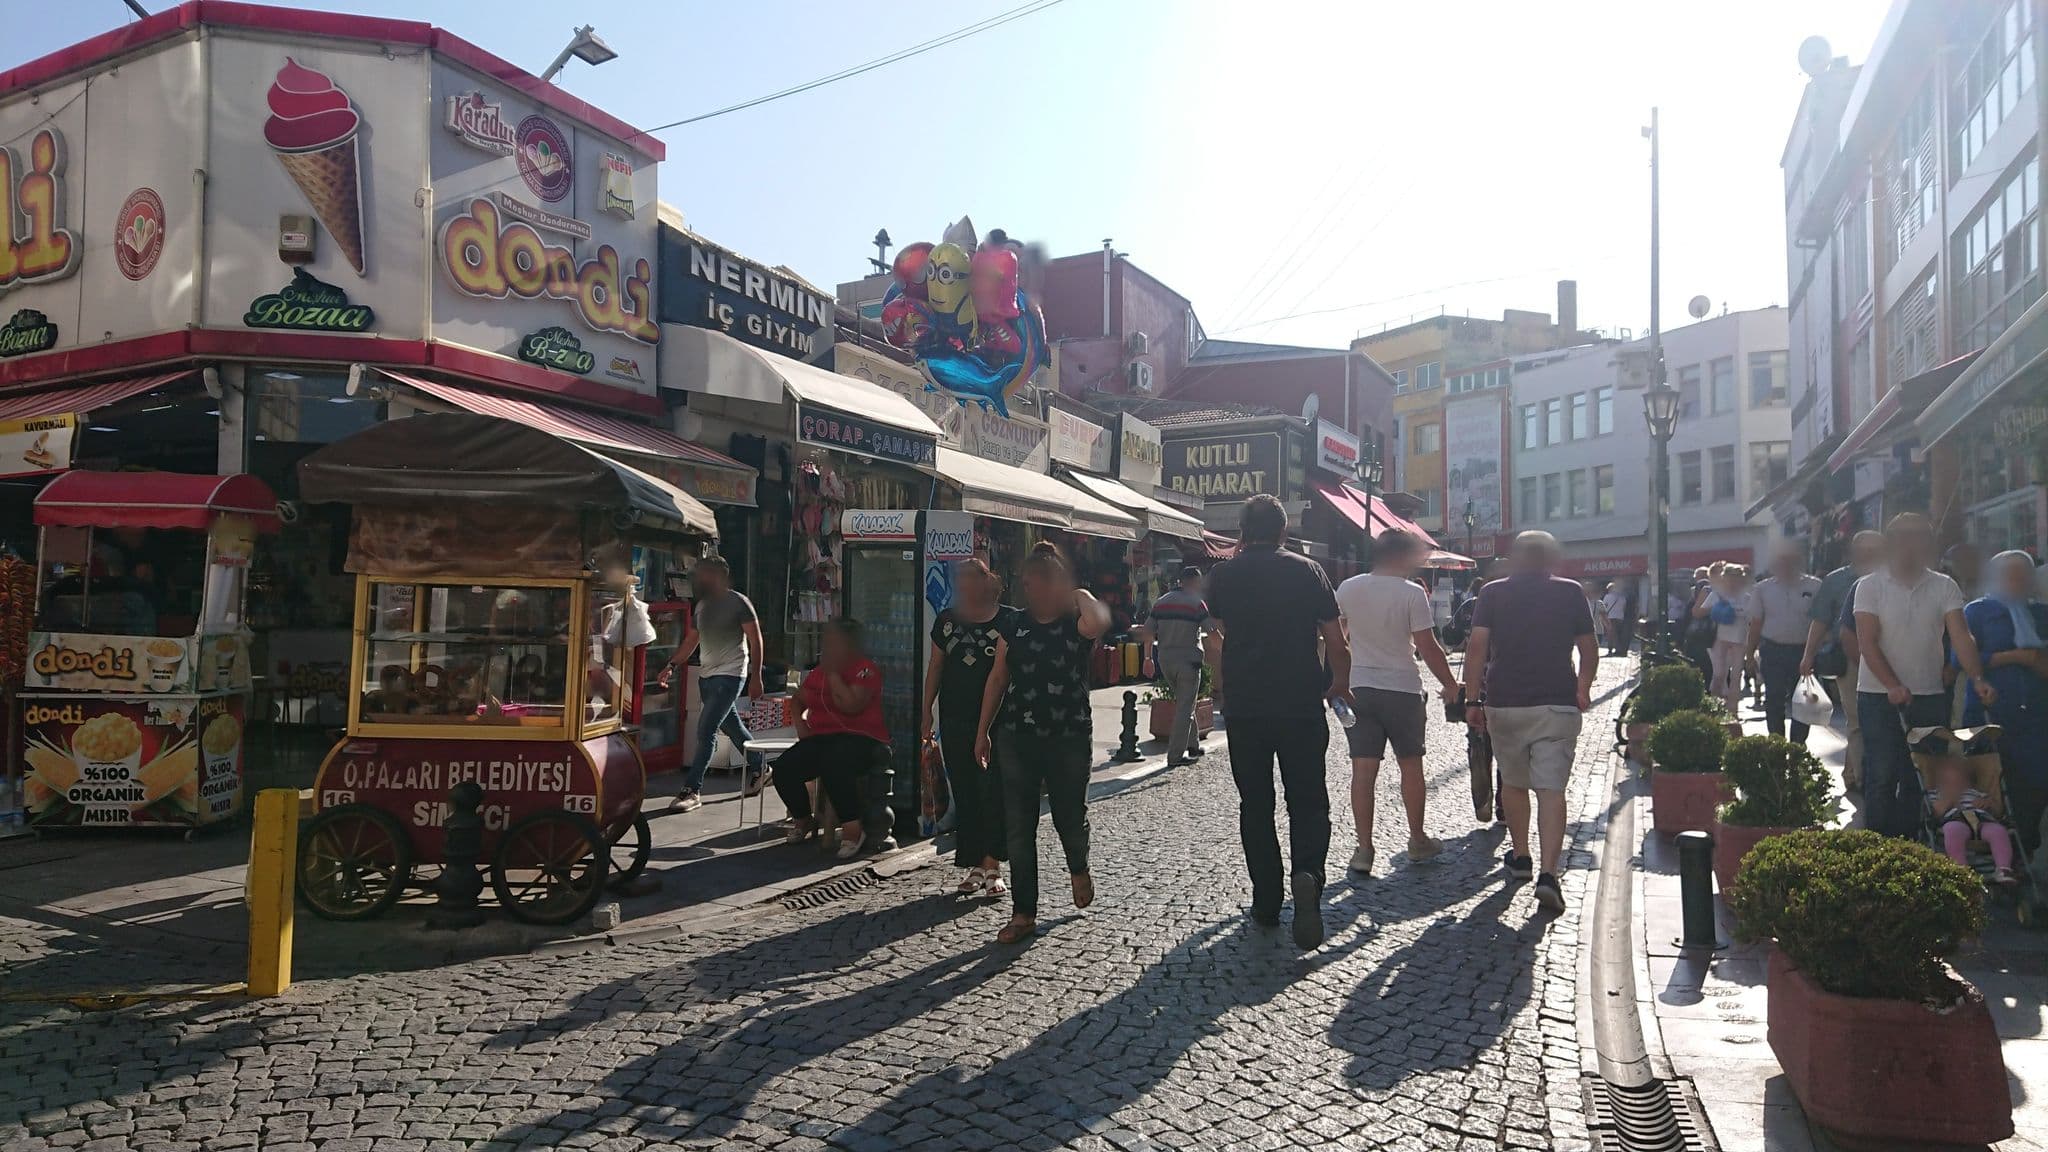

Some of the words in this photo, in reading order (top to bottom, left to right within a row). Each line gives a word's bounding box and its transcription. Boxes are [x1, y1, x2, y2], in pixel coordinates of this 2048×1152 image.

[441, 198, 660, 345] dondi
[708, 291, 735, 331] İÇ
[747, 313, 813, 354] GİYİM
[1186, 442, 1250, 468] KUTLU
[1172, 471, 1266, 496] BAHARAT
[852, 513, 903, 537] KALABAK
[927, 528, 973, 560] KALABAK
[1584, 560, 1632, 572] AKBANK
[33, 643, 137, 681] dondi
[25, 703, 86, 726] dondi
[84, 768, 130, 781] %100
[209, 761, 232, 778] %100
[448, 753, 571, 792] BELEDİYESİ
[69, 784, 145, 801] ORGANİK
[566, 797, 593, 812] 16
[84, 809, 130, 822] MISIR
